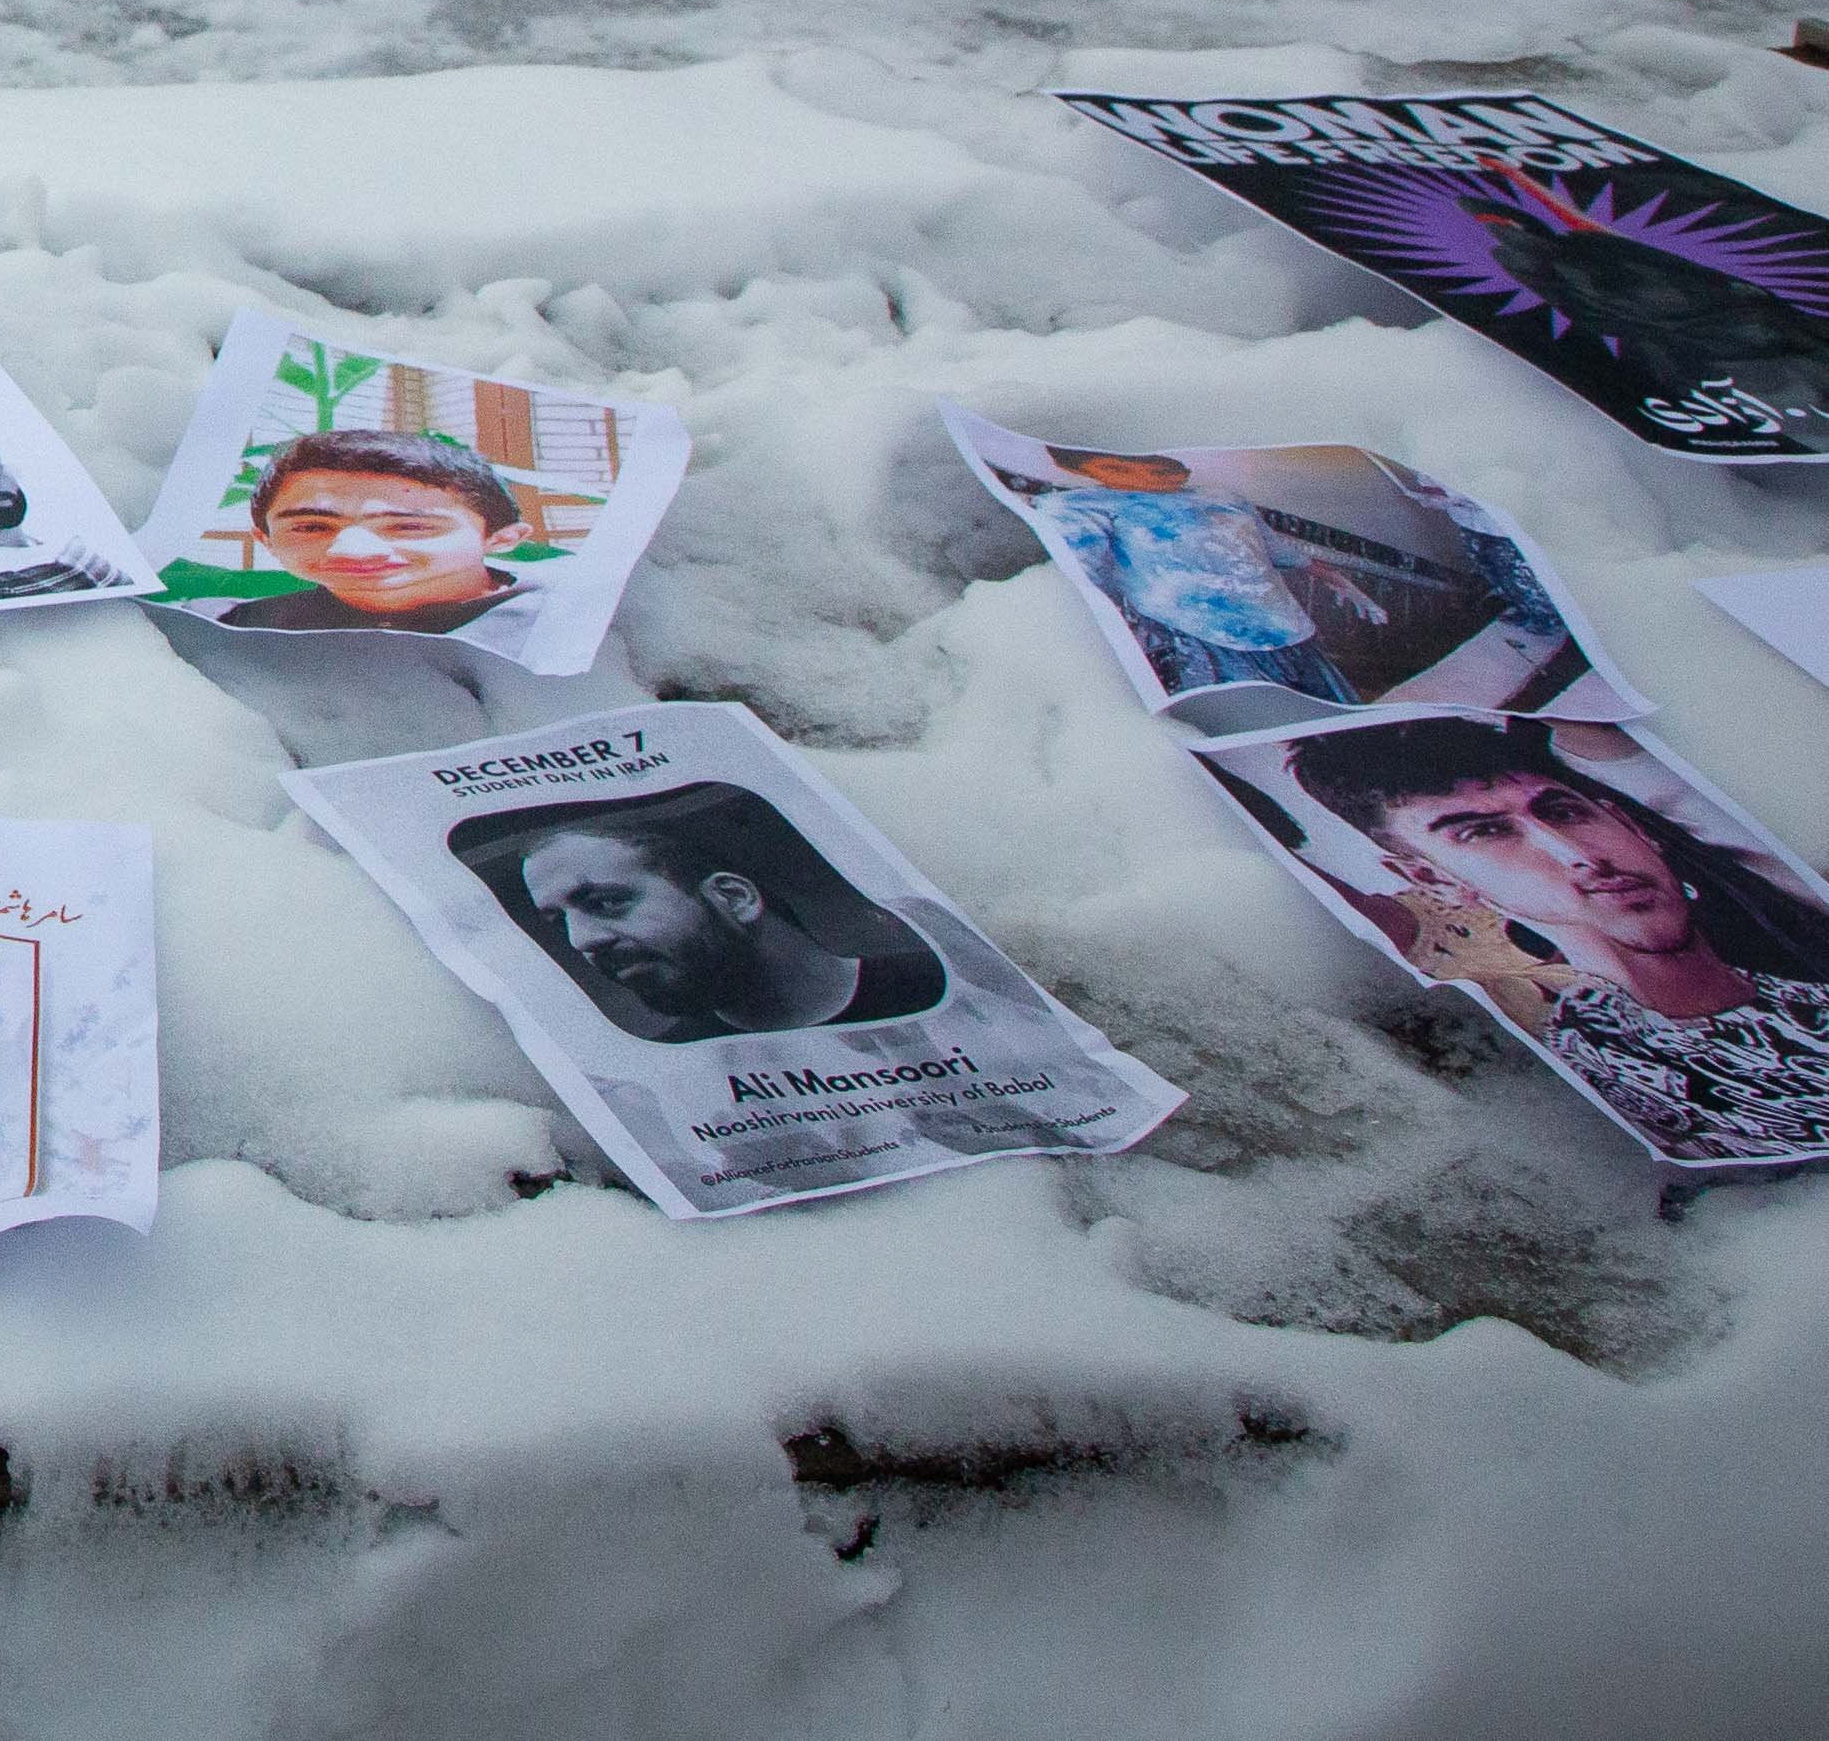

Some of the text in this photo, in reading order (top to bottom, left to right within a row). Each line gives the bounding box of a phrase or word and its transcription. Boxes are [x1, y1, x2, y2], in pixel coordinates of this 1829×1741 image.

[1067, 100, 1608, 145] WOMAN
[431, 729, 646, 787] DECEMBER 7
[451, 751, 671, 799] STUDENT DAY IN IRAN
[727, 1045, 980, 1103] Ali Mansoori
[691, 1073, 1057, 1143] Nooshirvani University of Babol
